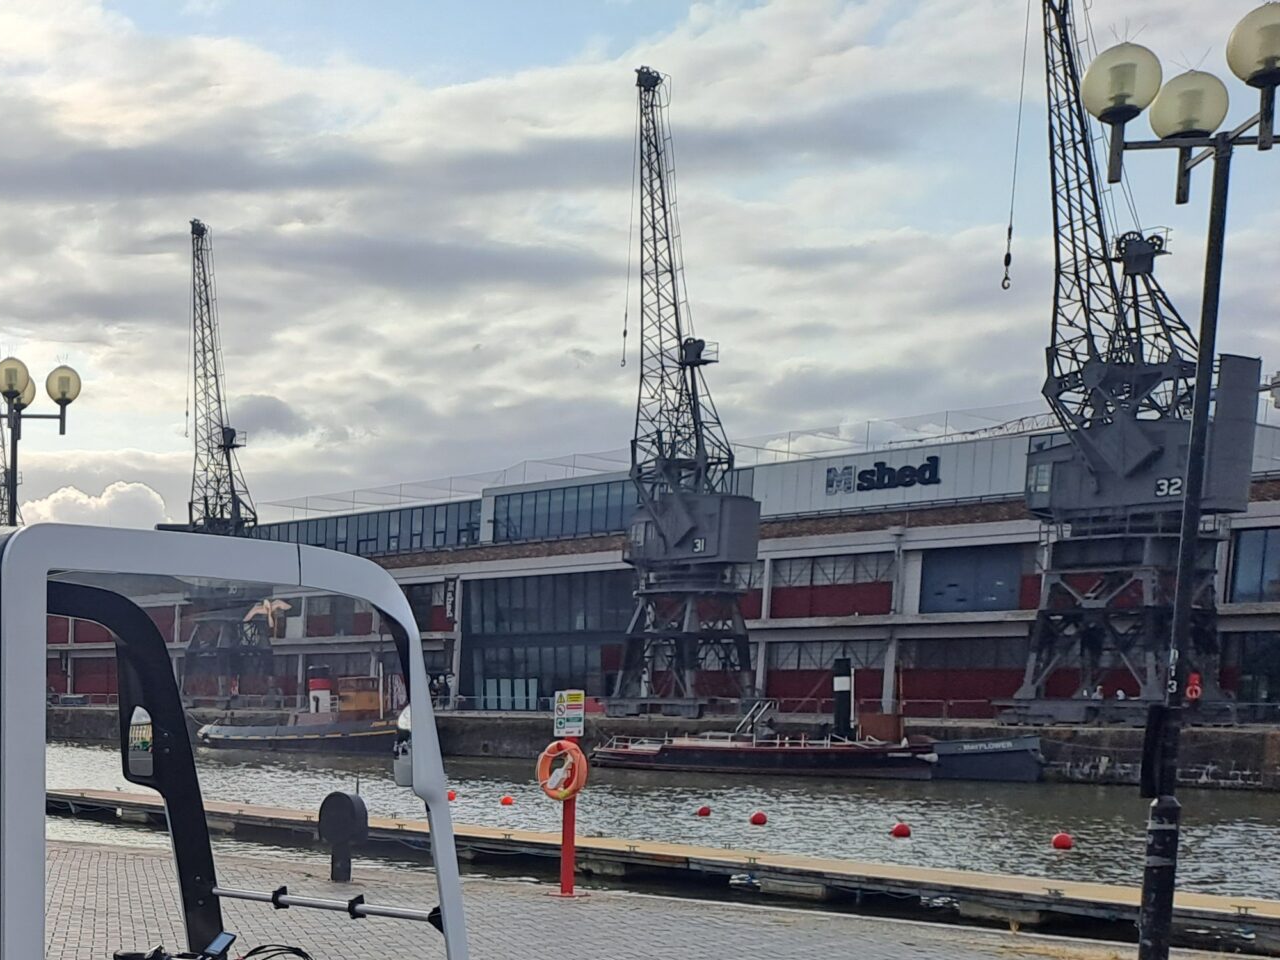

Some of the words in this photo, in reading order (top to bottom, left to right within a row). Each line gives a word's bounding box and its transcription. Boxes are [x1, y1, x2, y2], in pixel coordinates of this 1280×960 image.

[825, 465, 856, 496] M
[856, 456, 942, 491] shed
[1156, 478, 1182, 496] 32
[693, 539, 705, 552] 31
